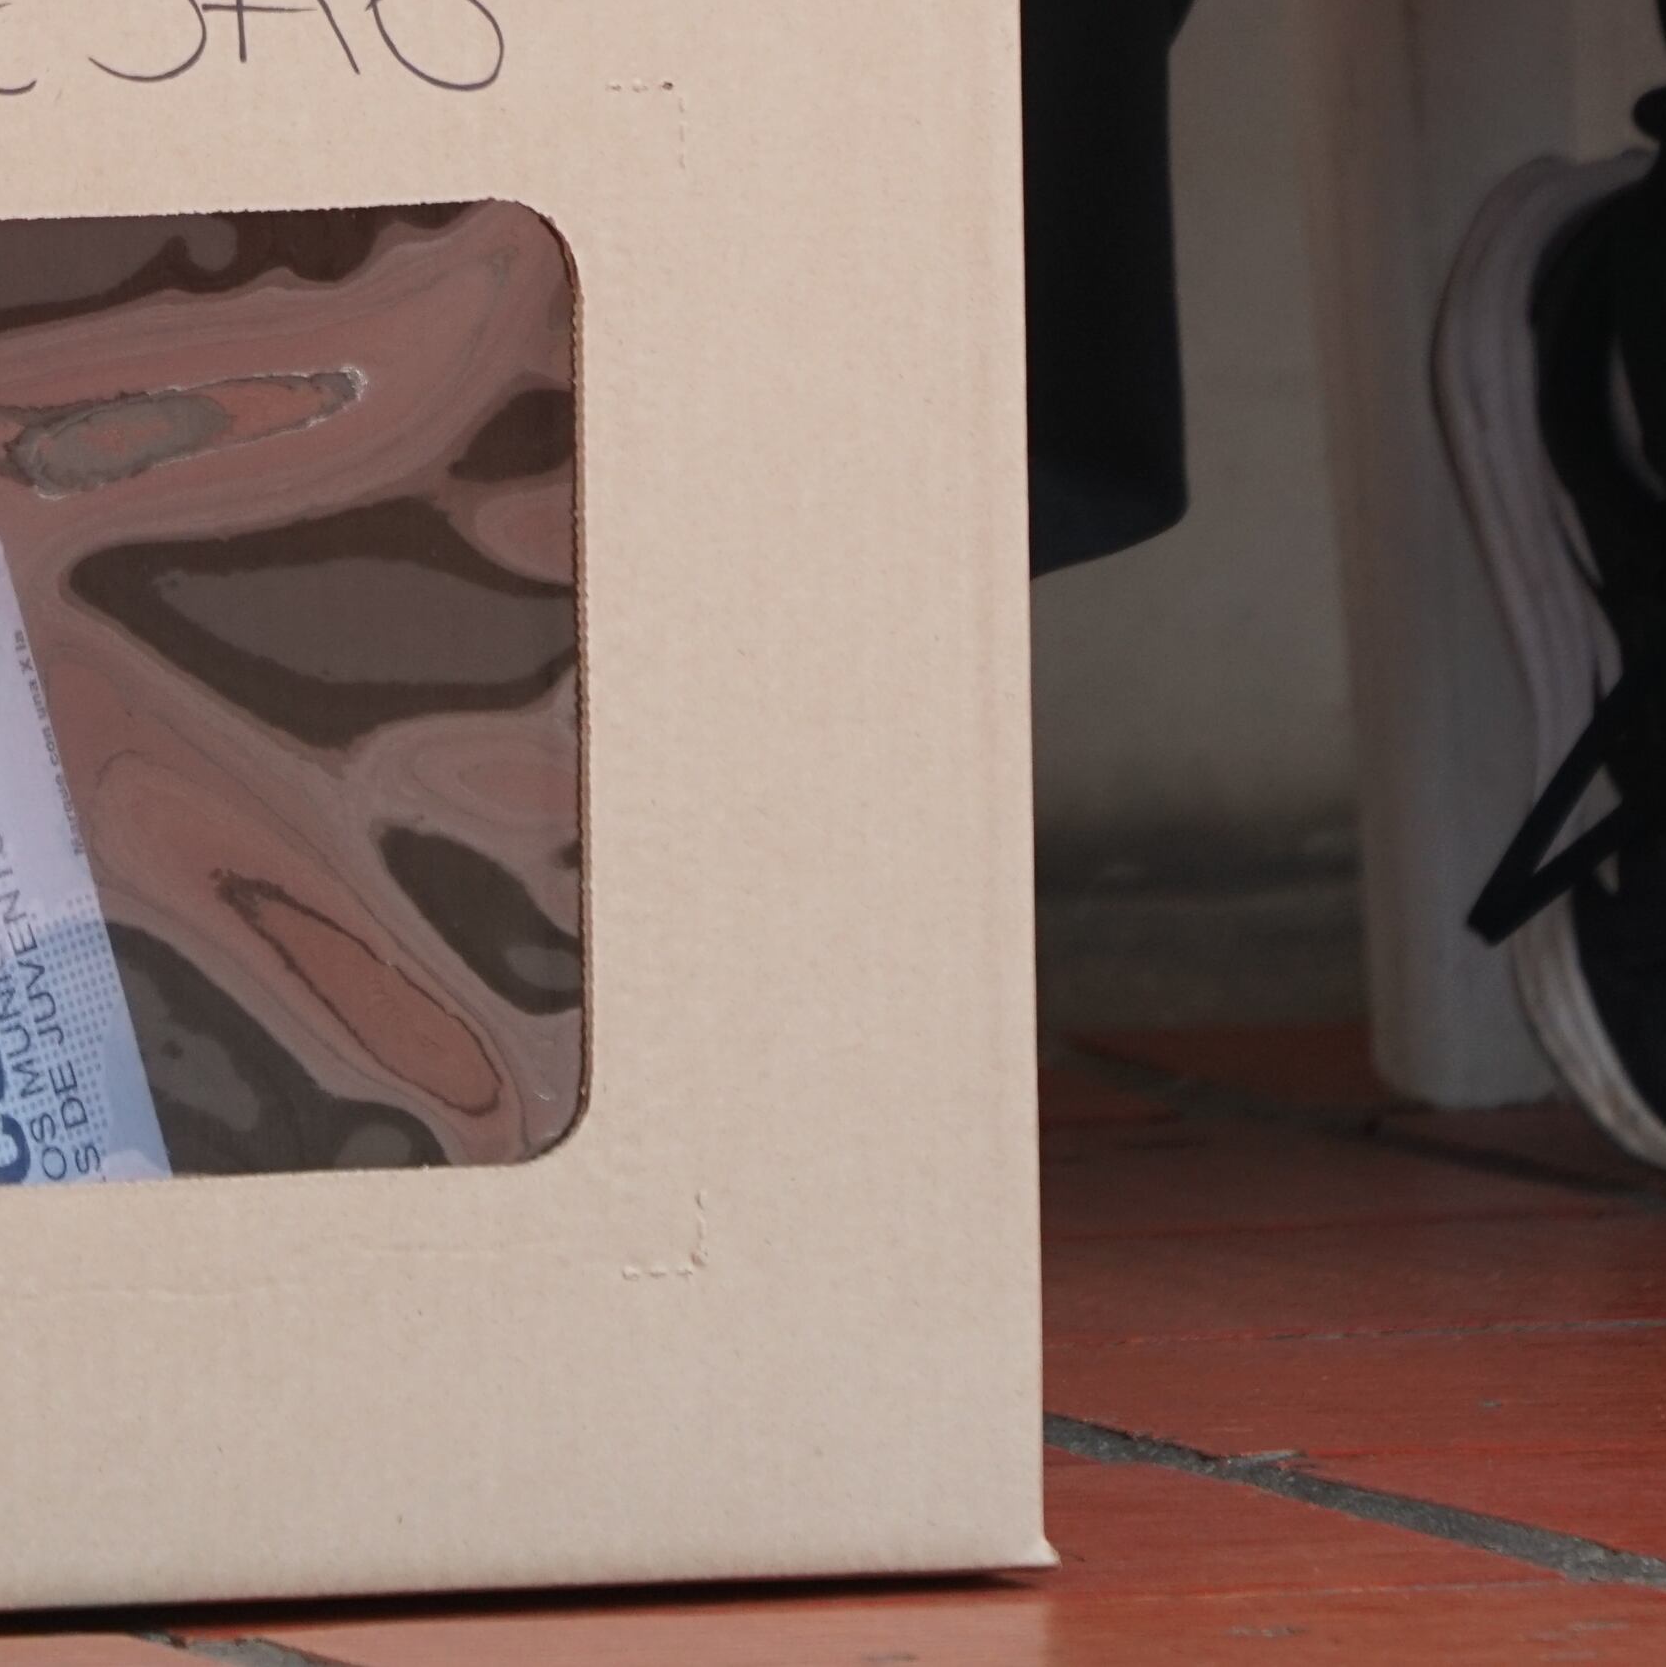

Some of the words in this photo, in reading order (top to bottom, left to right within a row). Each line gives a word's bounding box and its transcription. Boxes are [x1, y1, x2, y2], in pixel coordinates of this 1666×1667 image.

[48, 1060, 88, 1130] DE
[30, 1111, 67, 1181] OS
[75, 1142, 101, 1175] S
